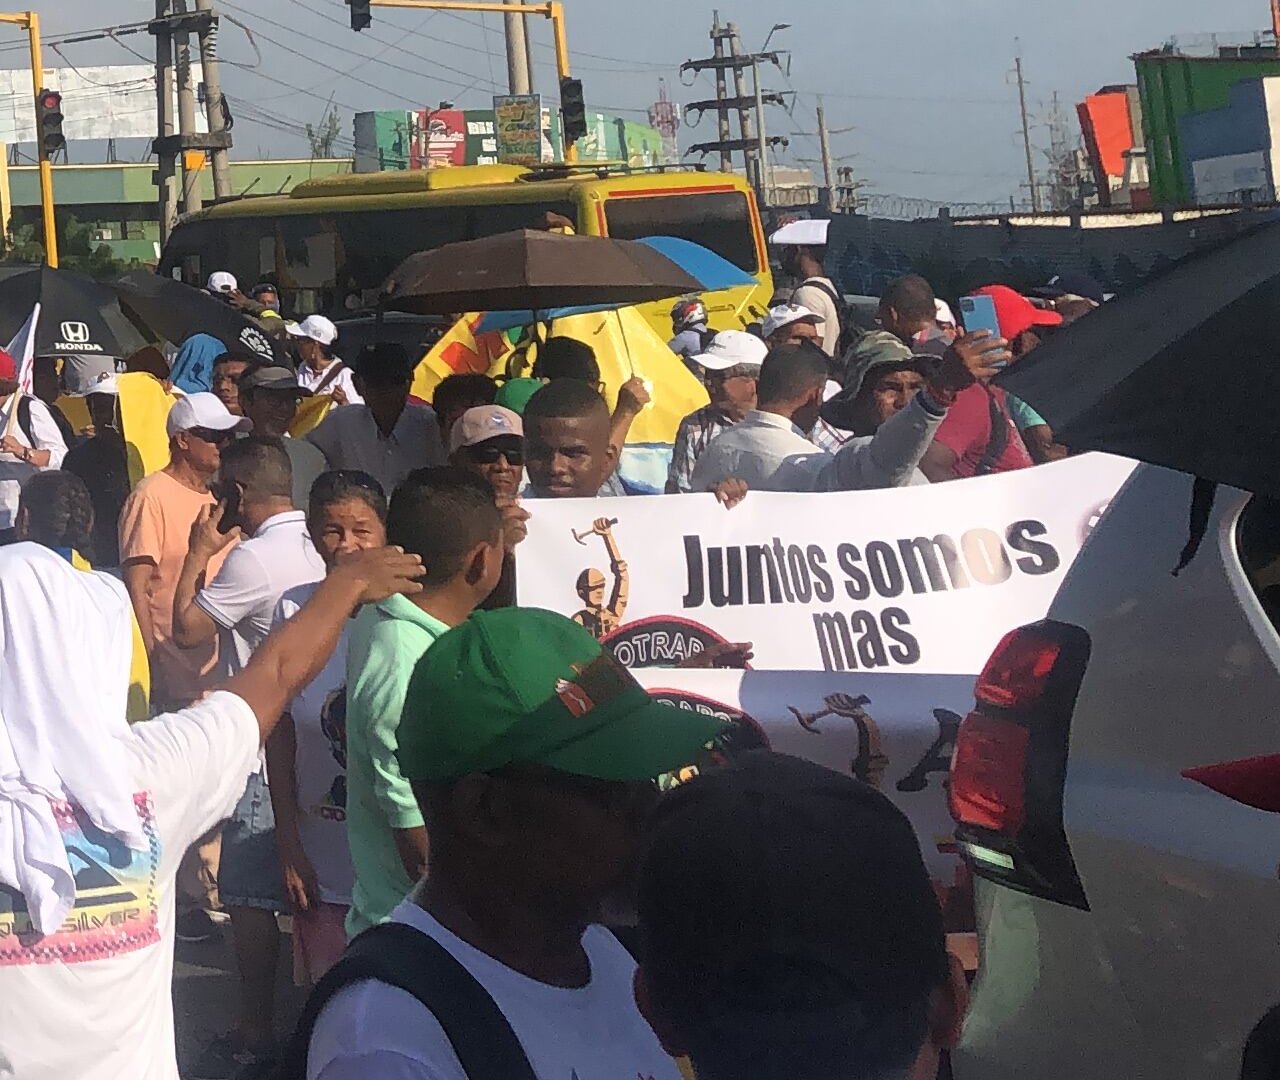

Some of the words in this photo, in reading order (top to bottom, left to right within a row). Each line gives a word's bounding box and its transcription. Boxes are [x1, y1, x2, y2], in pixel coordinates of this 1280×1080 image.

[54, 341, 104, 352] HONDA
[681, 533, 835, 609] Juntos
[836, 518, 1062, 601] somos
[812, 605, 922, 673] mas
